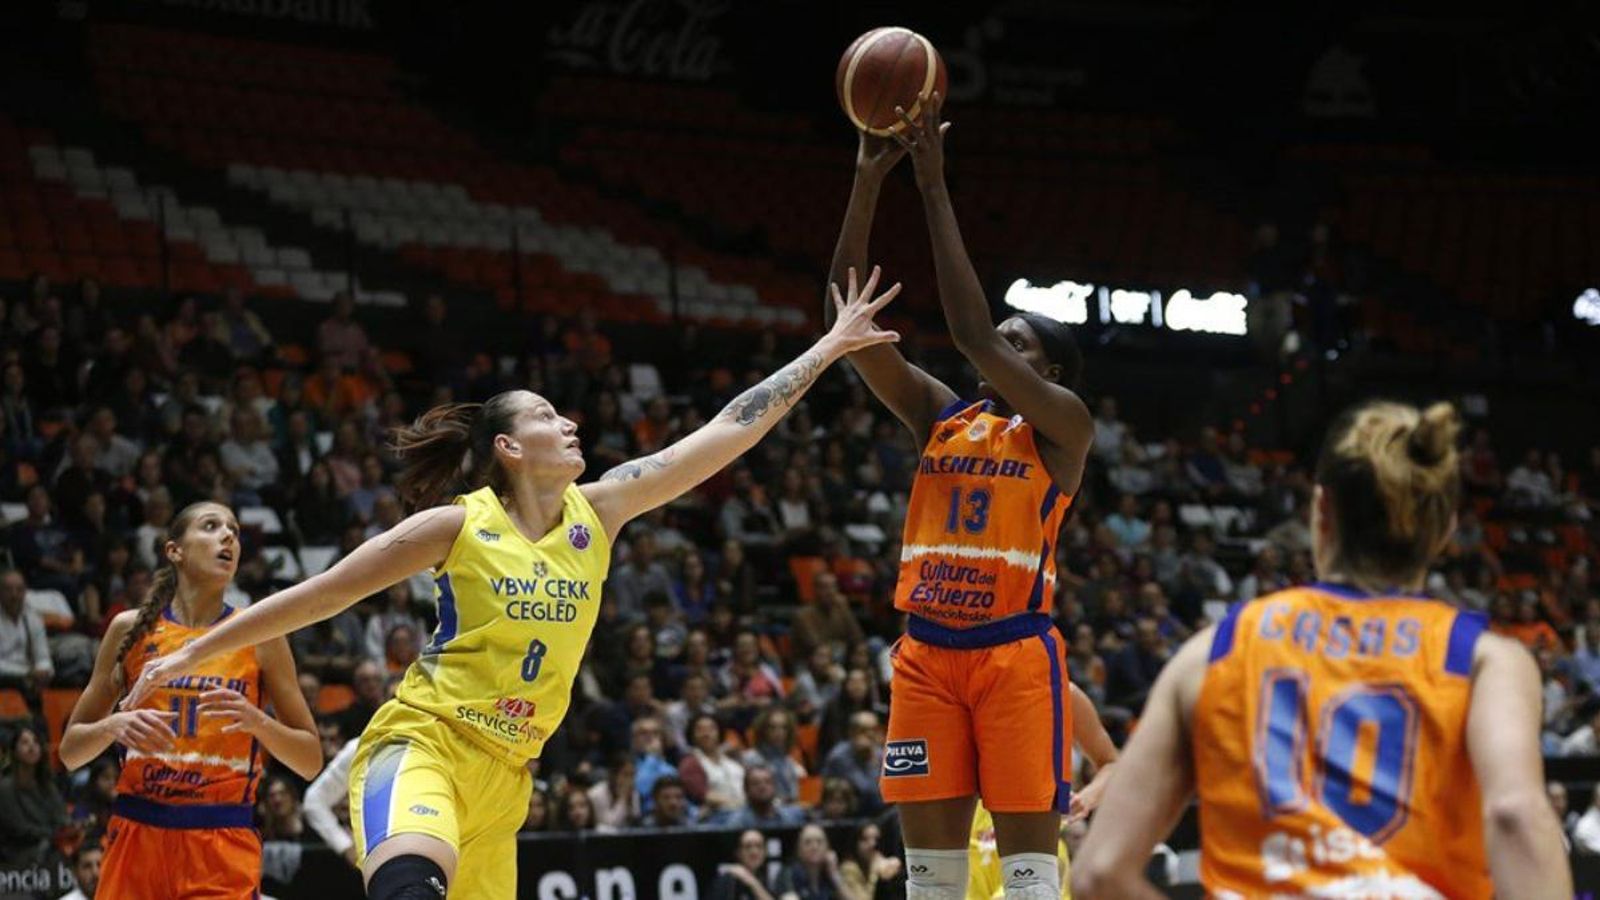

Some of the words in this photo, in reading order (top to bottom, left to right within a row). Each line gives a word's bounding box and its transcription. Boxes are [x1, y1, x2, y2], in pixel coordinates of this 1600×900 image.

[920, 456, 999, 477] ALENCIA
[999, 459, 1035, 480] BC
[945, 486, 993, 535] 13
[490, 577, 537, 596] VBW
[545, 579, 590, 600] CEKK
[920, 560, 979, 584] Cultura
[910, 581, 995, 608] Esfuerzo
[1260, 600, 1422, 658] CASAS
[521, 638, 547, 682] 8
[170, 695, 199, 737] 11
[1254, 668, 1421, 847] 10
[0, 865, 51, 892] encia
